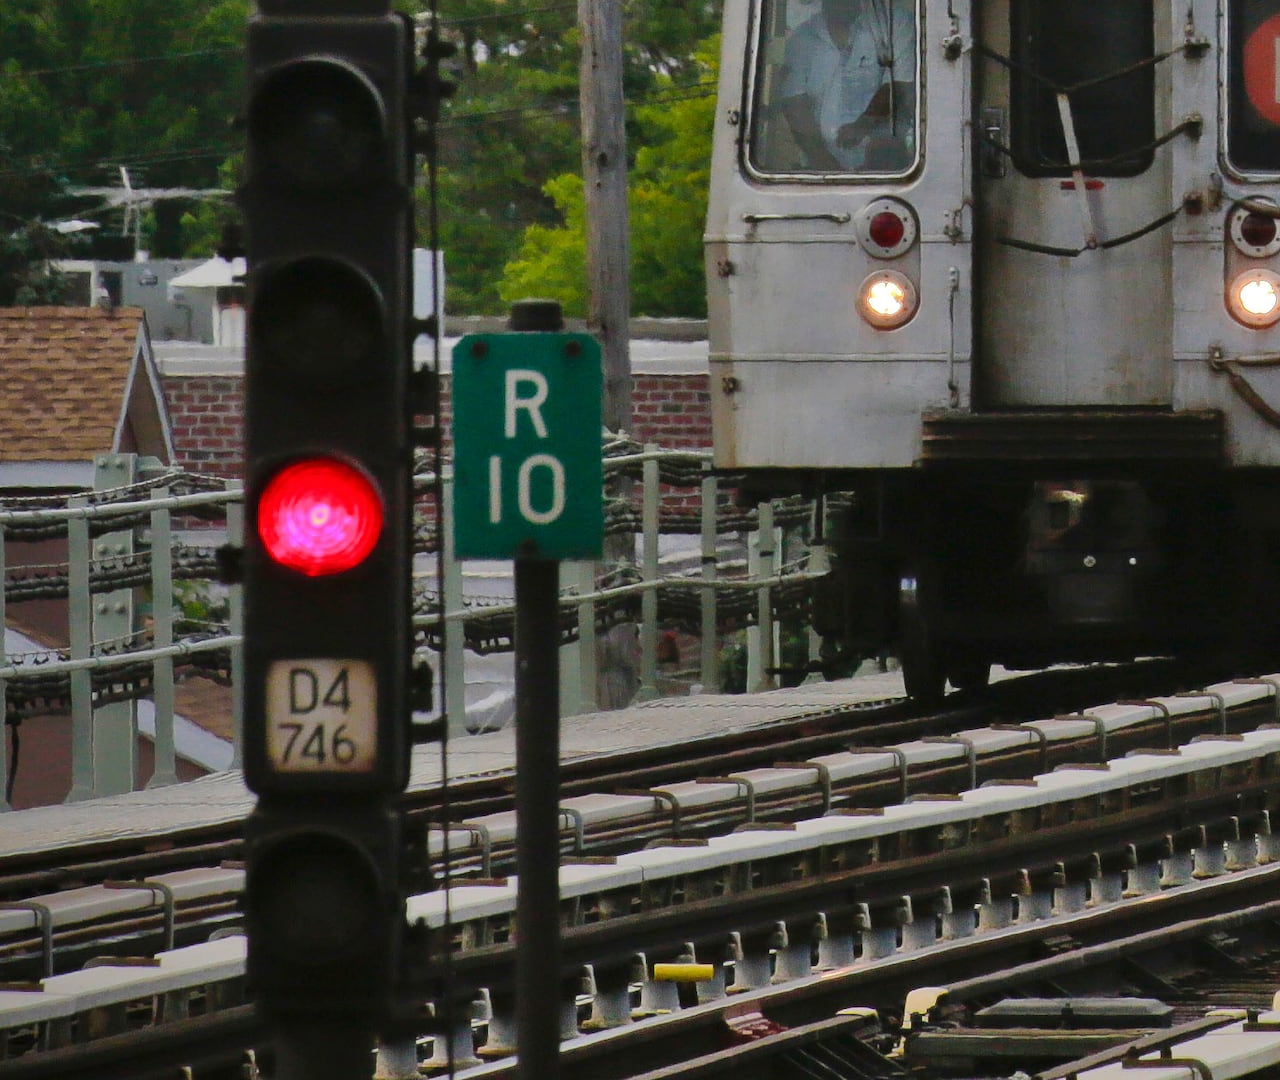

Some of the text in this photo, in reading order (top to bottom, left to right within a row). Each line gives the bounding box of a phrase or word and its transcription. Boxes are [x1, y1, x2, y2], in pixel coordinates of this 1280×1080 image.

[504, 369, 549, 439] R
[289, 668, 352, 716] D4
[277, 722, 357, 766] 746
